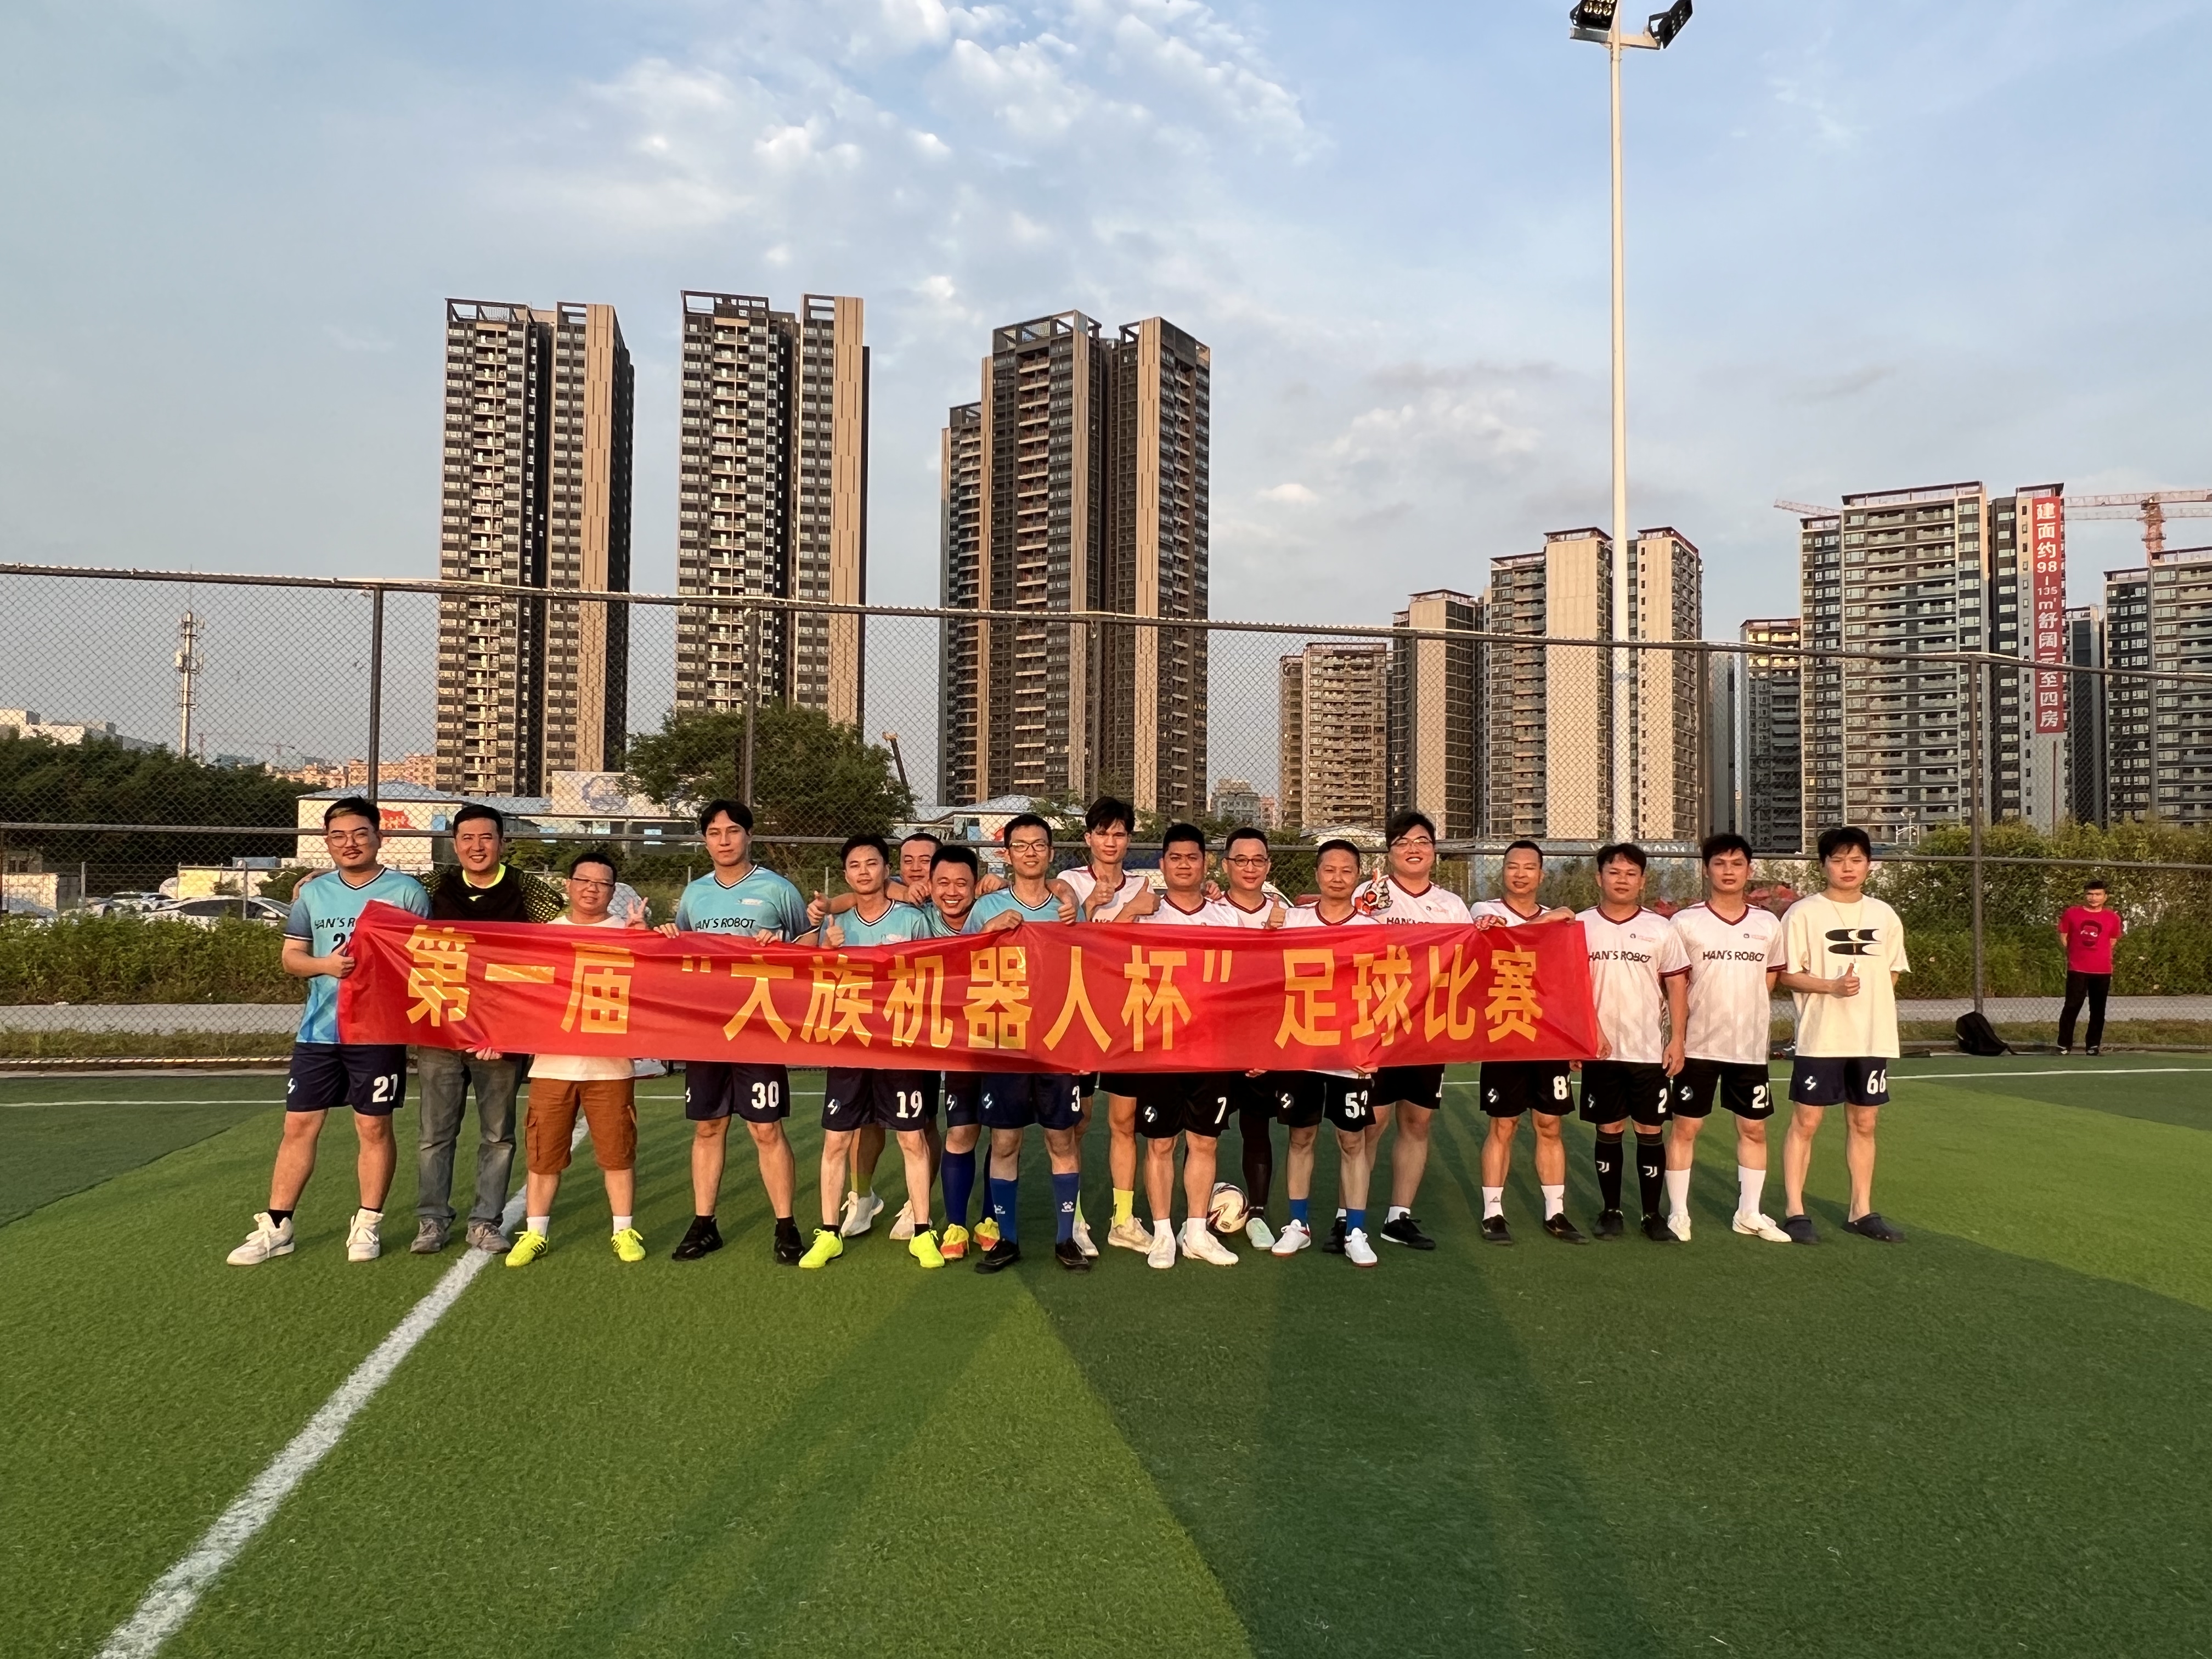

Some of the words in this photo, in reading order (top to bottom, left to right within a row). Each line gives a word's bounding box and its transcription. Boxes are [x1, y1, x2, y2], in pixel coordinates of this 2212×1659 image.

[720, 917, 756, 929] ROBOT
[1702, 950, 1732, 961] HAN'S
[405, 924, 635, 1034] 第一届
[1274, 944, 1543, 1049] 足球比赛
[752, 1081, 779, 1109] 30
[1866, 1069, 1886, 1095] 66
[896, 1090, 923, 1119] 19
[1214, 1097, 1227, 1125] 7
